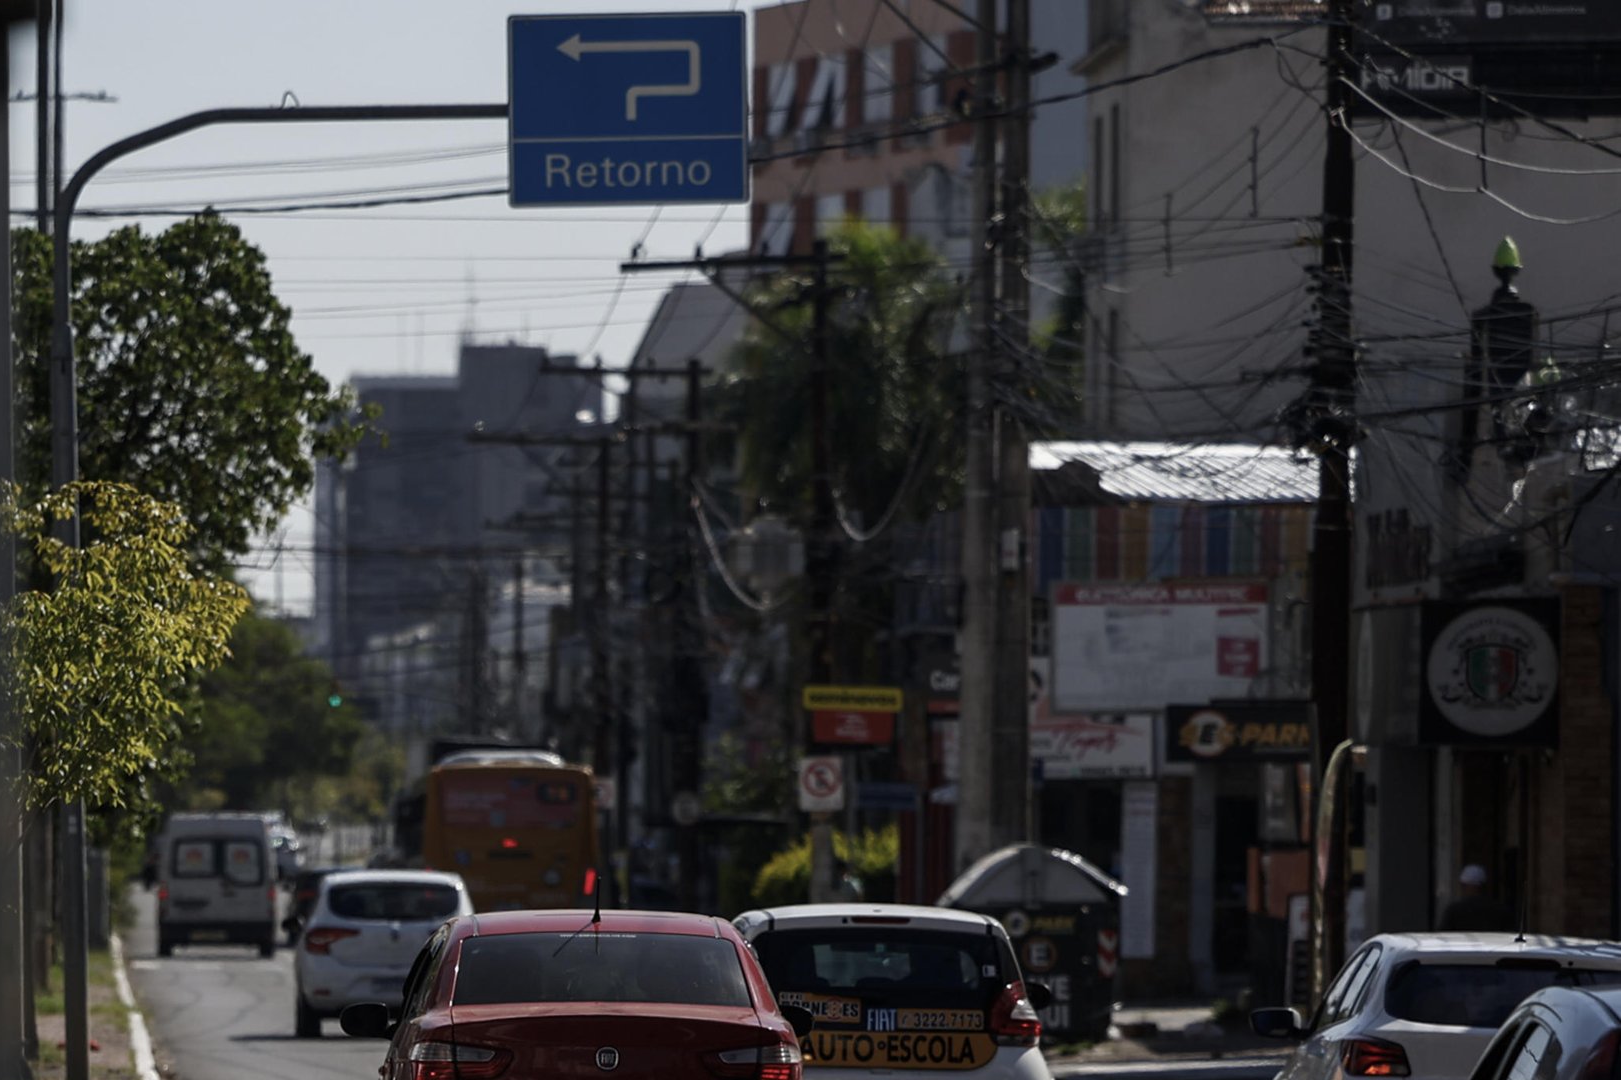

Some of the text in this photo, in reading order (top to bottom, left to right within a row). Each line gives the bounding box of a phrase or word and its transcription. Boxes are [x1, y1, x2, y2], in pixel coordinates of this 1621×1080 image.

[545, 153, 711, 187] Retorno
[867, 1008, 984, 1031] FIAT 3222.7173
[800, 1034, 975, 1064] AUTO ESCOLA
